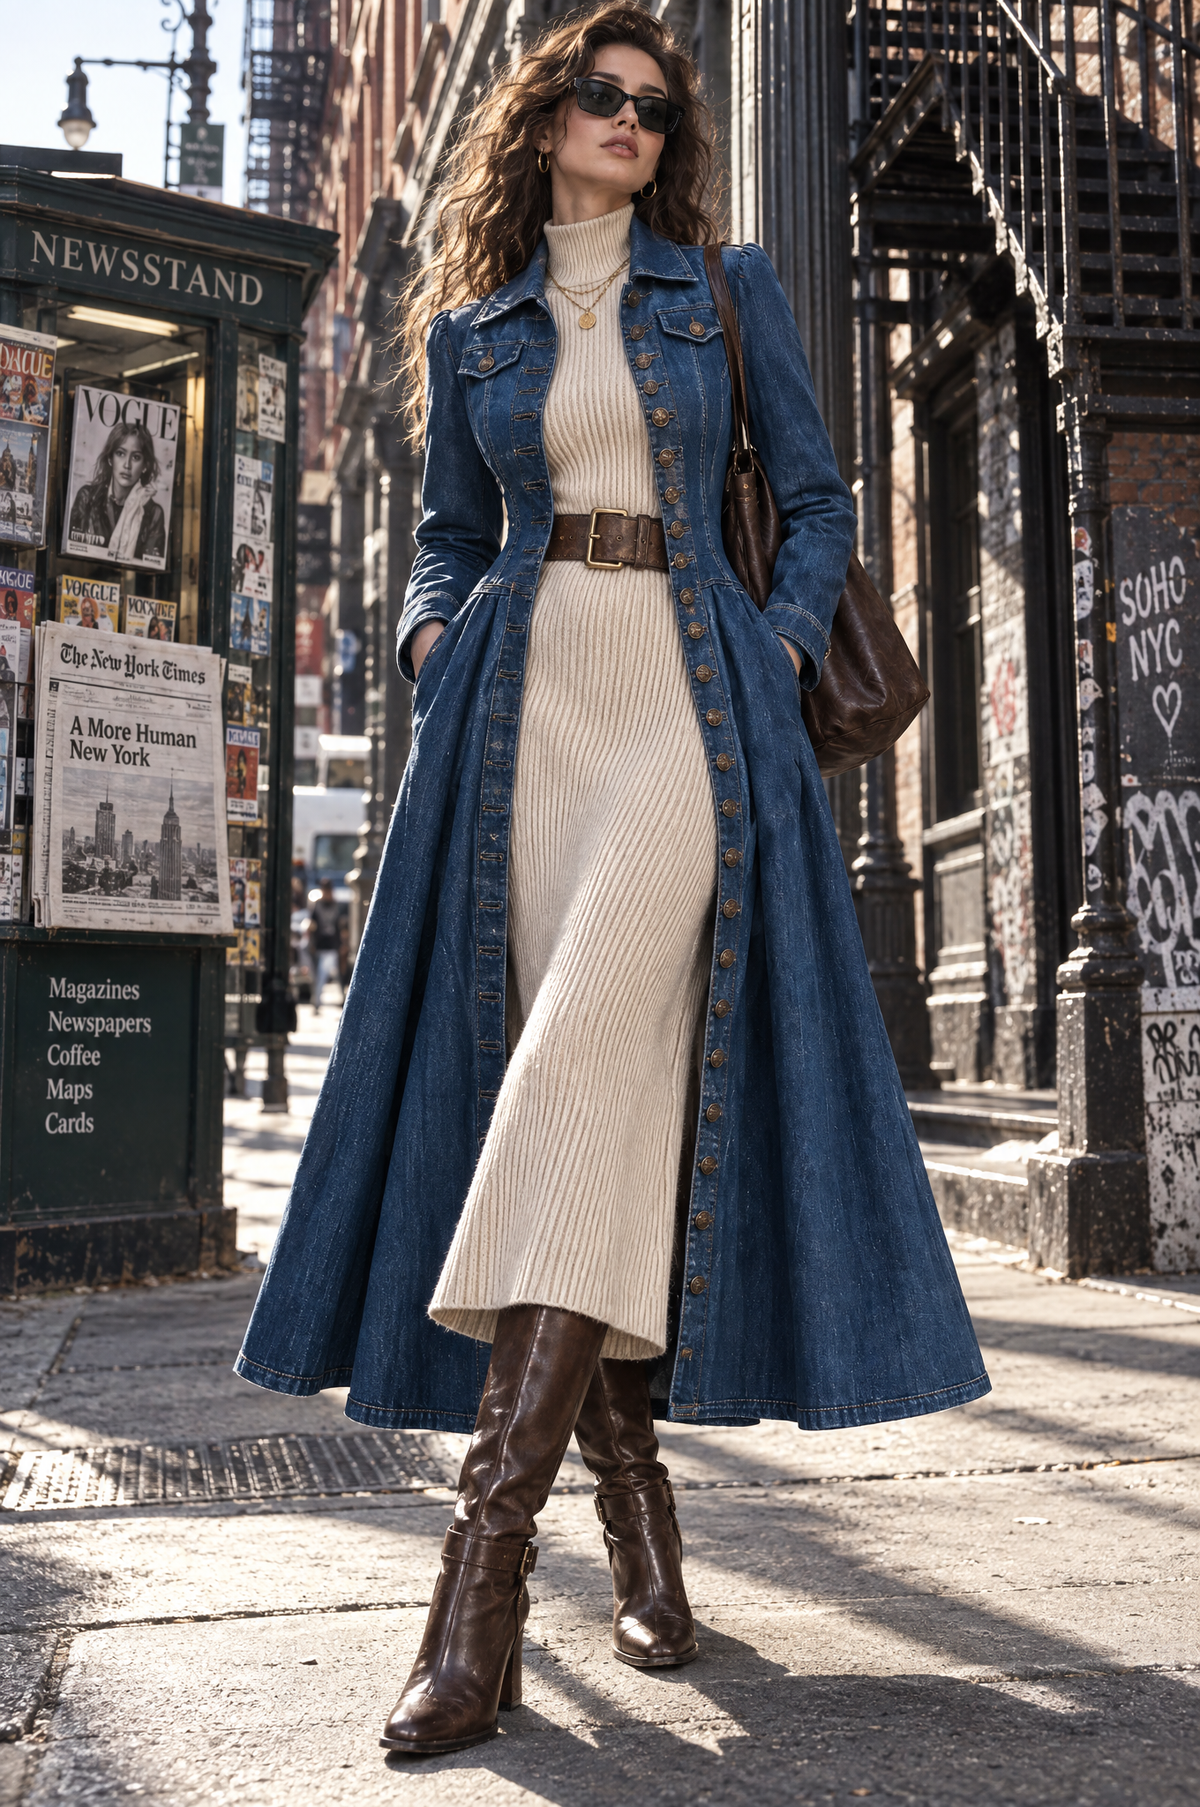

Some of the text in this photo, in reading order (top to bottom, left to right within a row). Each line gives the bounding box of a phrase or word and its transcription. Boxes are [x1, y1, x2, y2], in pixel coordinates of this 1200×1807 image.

[30, 230, 263, 306] NEWSSTAND
[82, 389, 178, 442] VOGUE
[1119, 555, 1187, 627] SOHO
[60, 642, 89, 669] The
[91, 648, 123, 672] New
[124, 653, 160, 679] York
[162, 659, 206, 685] Times
[1129, 617, 1183, 682] NYC
[69, 715, 84, 737] A
[87, 716, 132, 742] More
[135, 722, 198, 749] Human
[69, 738, 151, 768] New York
[49, 977, 140, 1004] Magazines
[48, 1010, 152, 1038] Newspapers
[47, 1043, 101, 1066] Coffee
[46, 1078, 93, 1105] Maps
[45, 1111, 94, 1134] Cards
